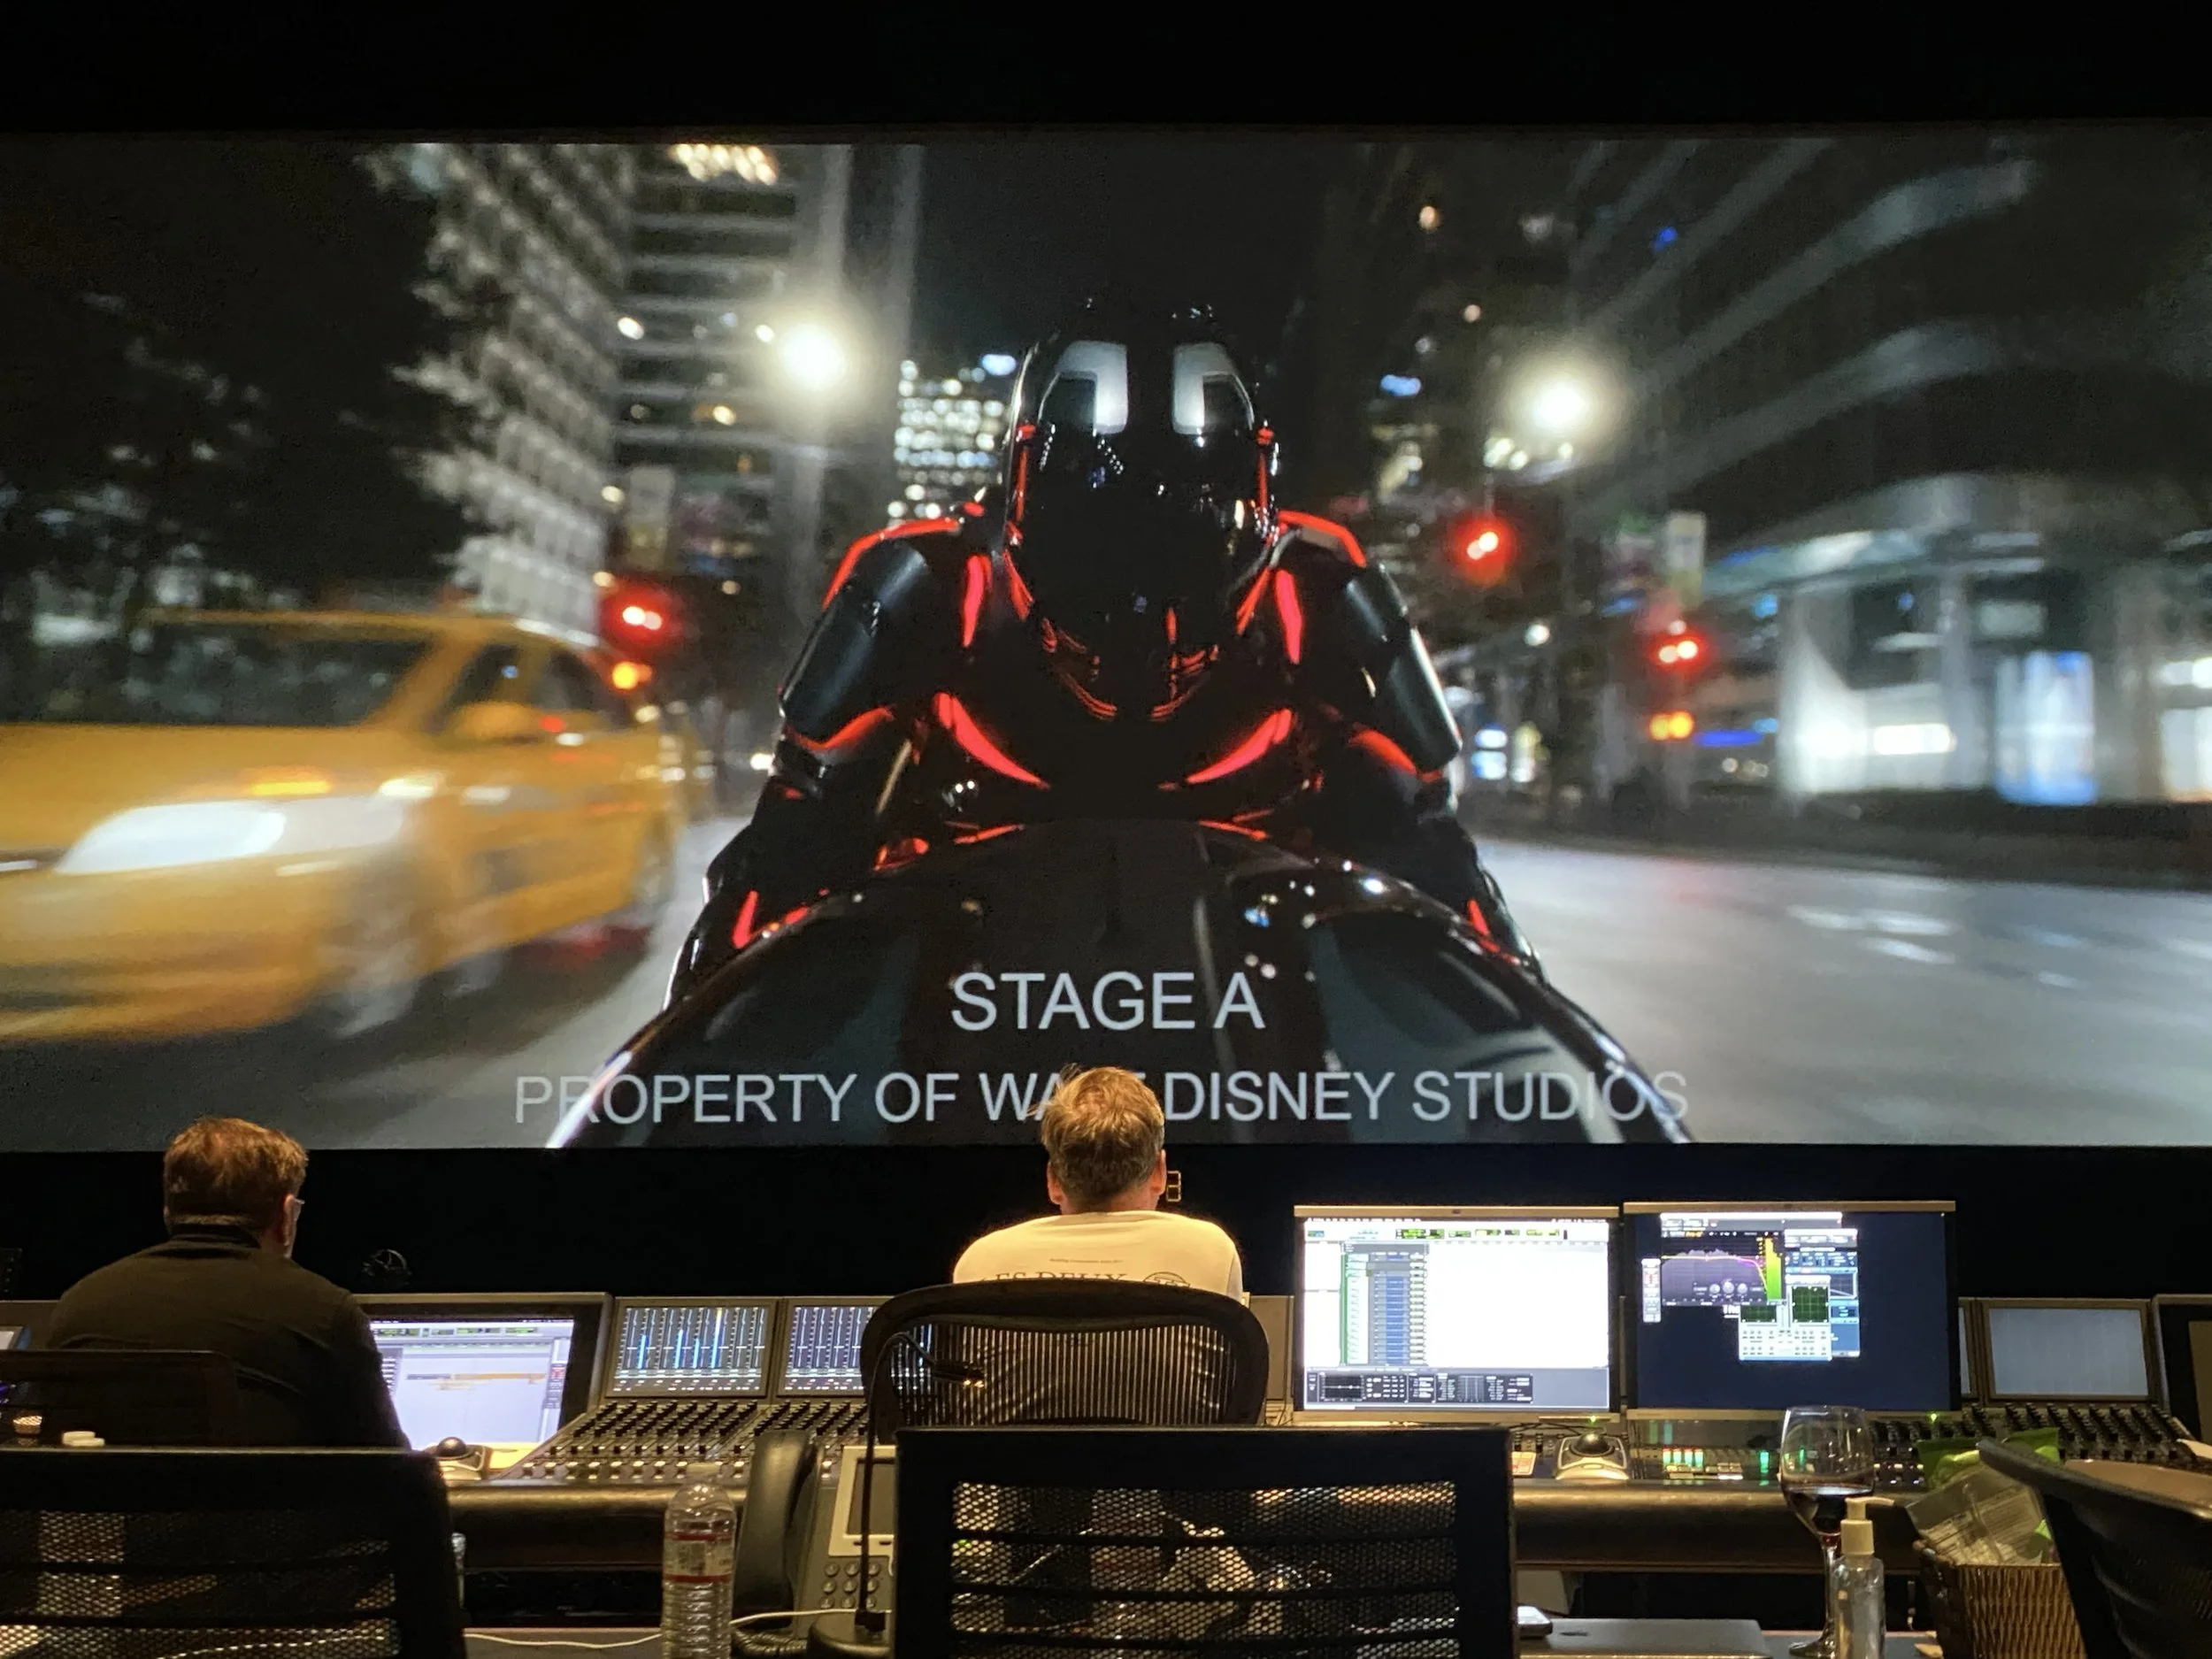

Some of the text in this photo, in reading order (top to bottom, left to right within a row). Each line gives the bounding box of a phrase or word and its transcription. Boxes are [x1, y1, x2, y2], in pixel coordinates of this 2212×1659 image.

[951, 972, 1266, 1031] STAGE A
[515, 1072, 857, 1124] PROPERTY
[875, 1071, 960, 1123] OF
[1164, 1071, 1395, 1122] DISNEY
[1412, 1070, 1688, 1123] STUDIOS
